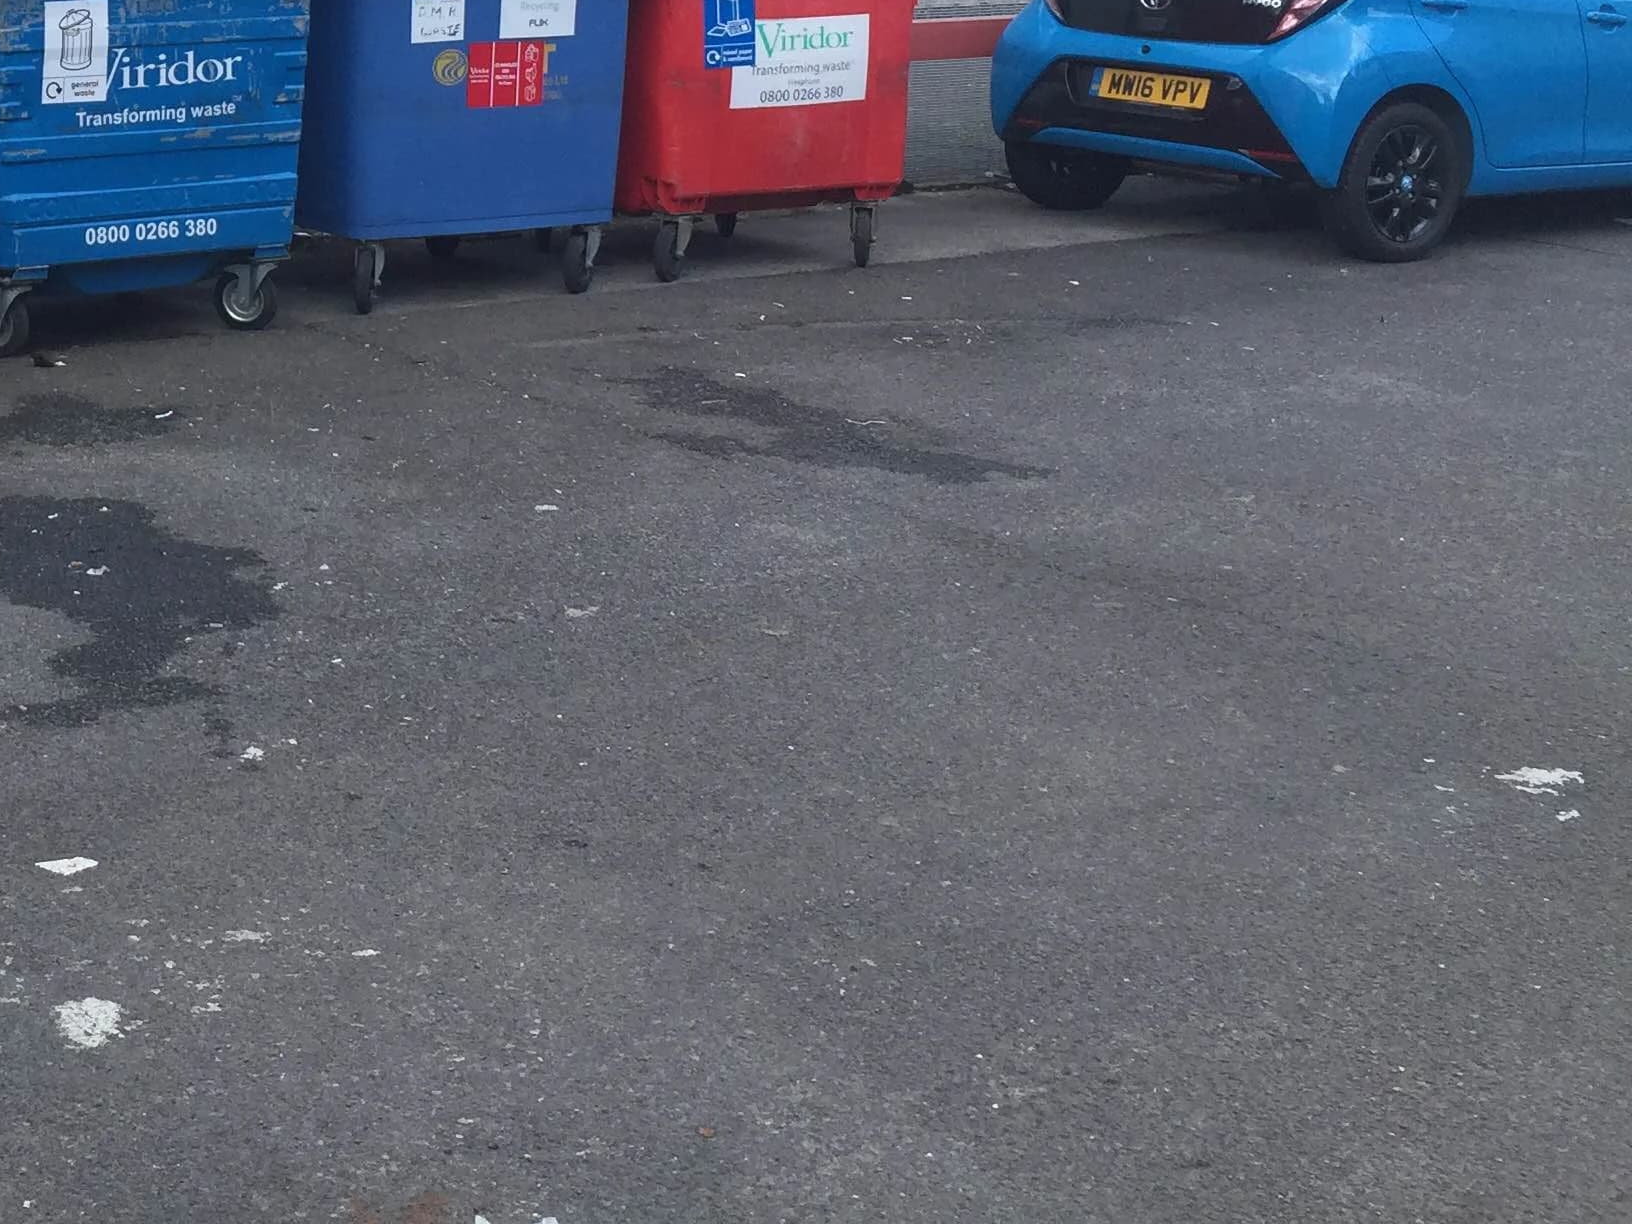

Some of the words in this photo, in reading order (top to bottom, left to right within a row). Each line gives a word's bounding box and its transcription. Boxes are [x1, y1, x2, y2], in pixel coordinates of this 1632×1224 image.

[756, 22, 853, 58] Viridor
[752, 61, 819, 76] Transforming
[822, 60, 852, 72] waste
[760, 89, 790, 103] 0800
[793, 87, 821, 101] 0266
[823, 85, 844, 98] 380
[1161, 78, 1202, 104] VPV
[75, 105, 186, 128] Transforming
[85, 226, 129, 246] 0800
[135, 221, 179, 241] 0266
[184, 217, 217, 237] 380
